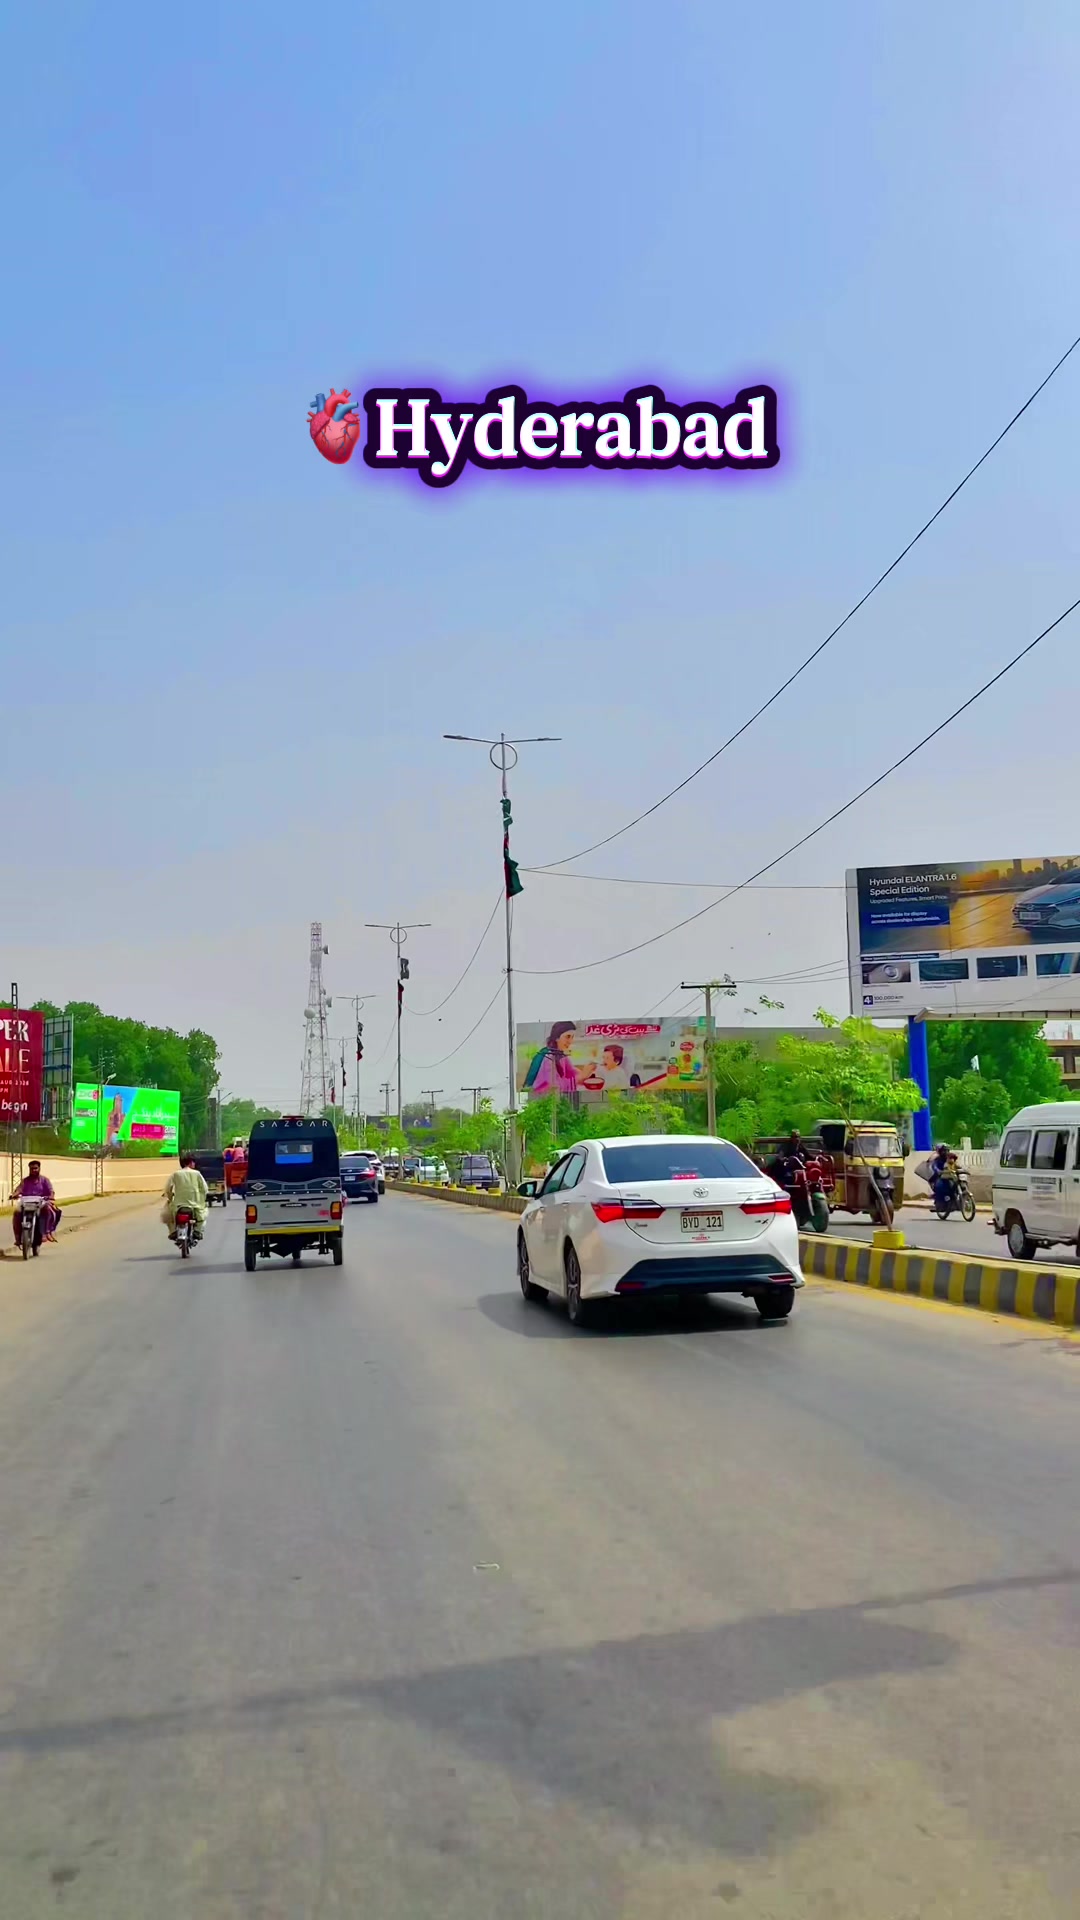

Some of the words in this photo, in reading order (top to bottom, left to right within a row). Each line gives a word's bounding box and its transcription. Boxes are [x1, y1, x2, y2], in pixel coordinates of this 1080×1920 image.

[869, 877, 904, 887] Hyundai
[905, 874, 945, 884] ELANTRA
[946, 873, 957, 881] 1.6
[869, 887, 900, 897] Special
[901, 885, 930, 894] Edition
[259, 1120, 328, 1128] SAZGAR
[682, 1217, 700, 1229] BYD
[706, 1216, 722, 1228] 121
